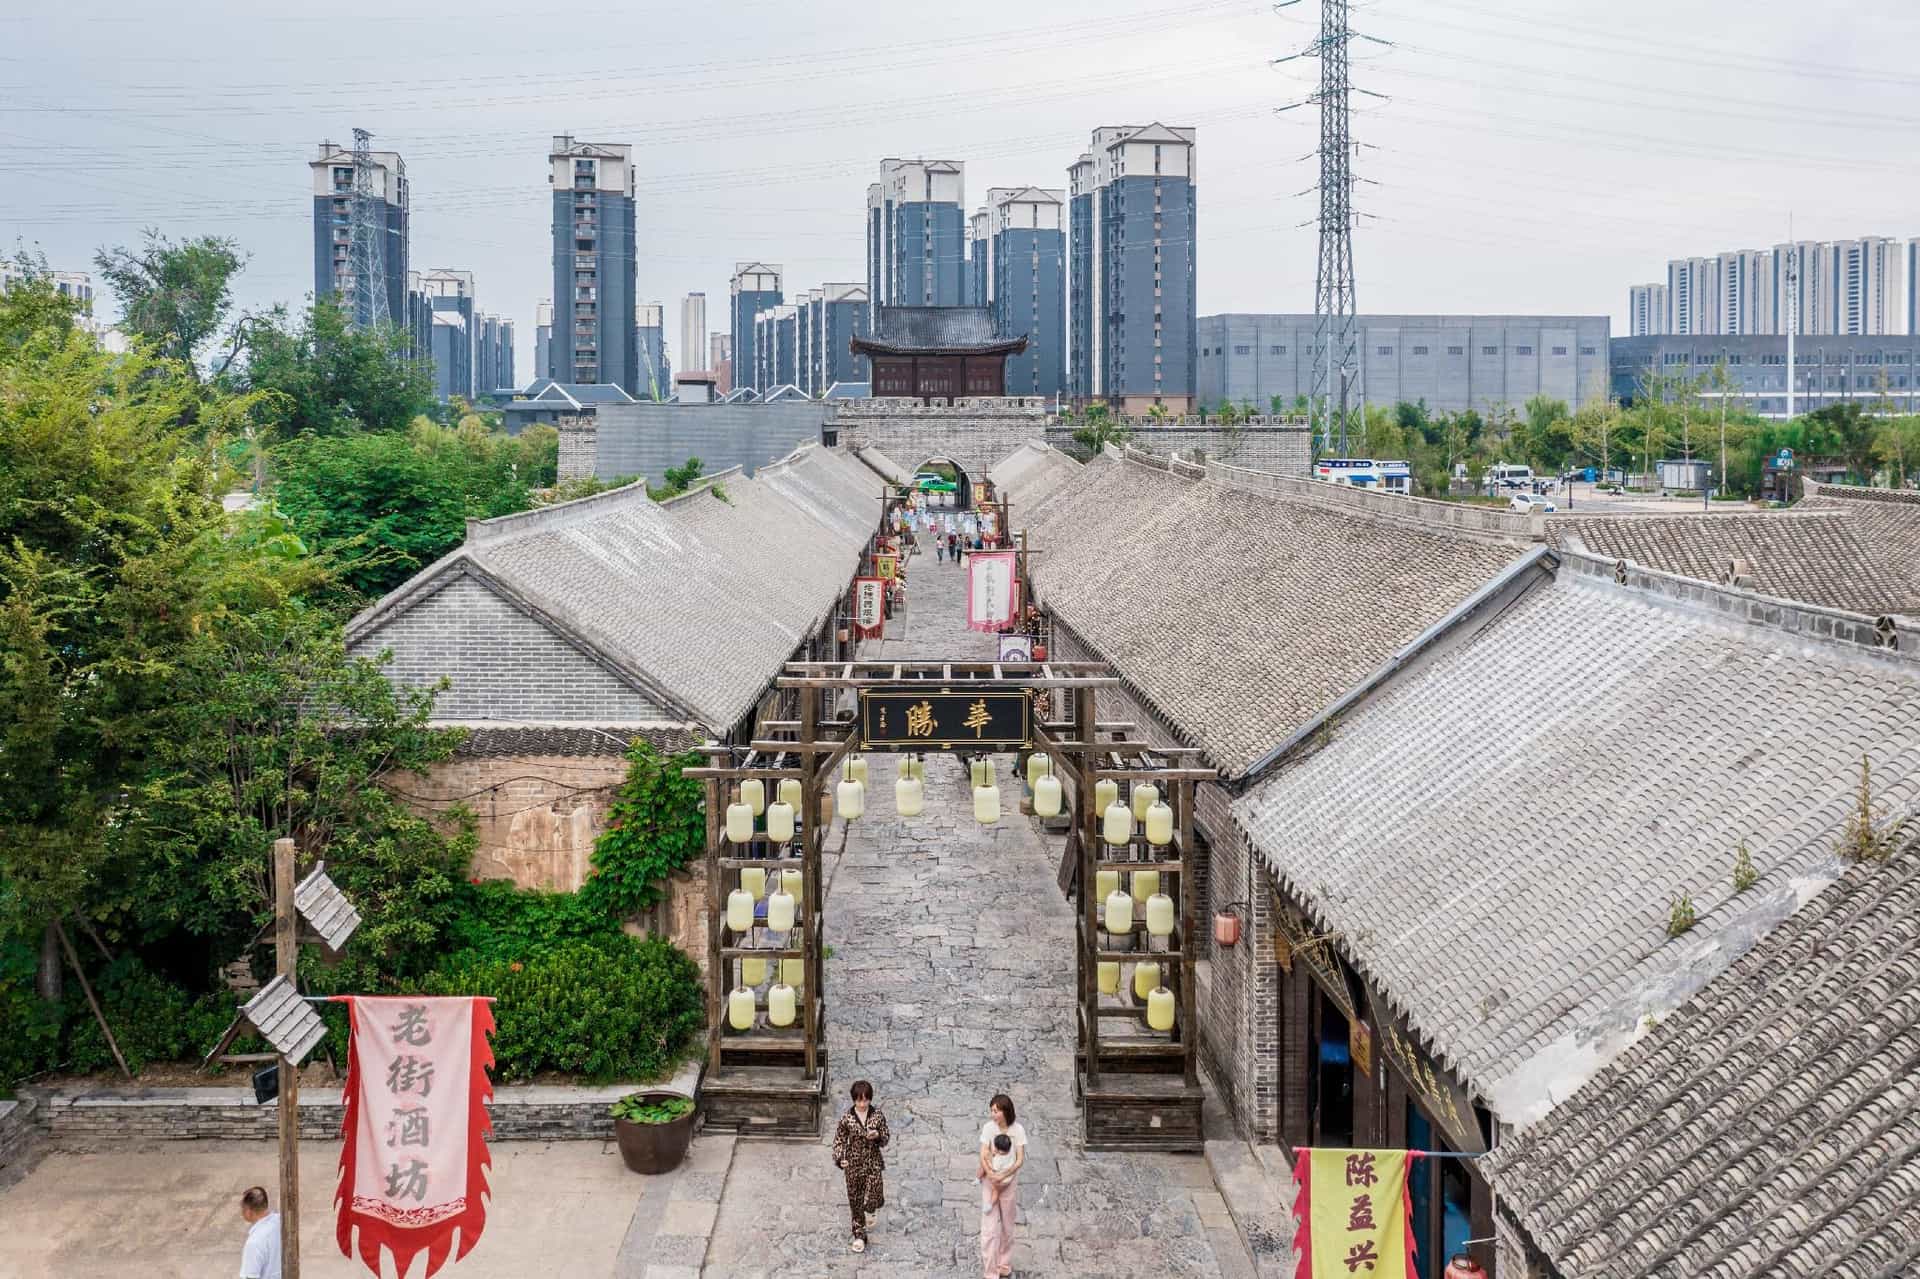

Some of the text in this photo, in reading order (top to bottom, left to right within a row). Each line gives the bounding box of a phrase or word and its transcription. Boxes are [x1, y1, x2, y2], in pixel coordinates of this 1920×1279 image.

[385, 1003, 435, 1202] 老街酒坊
[1344, 1153, 1379, 1272] 陈益兴
